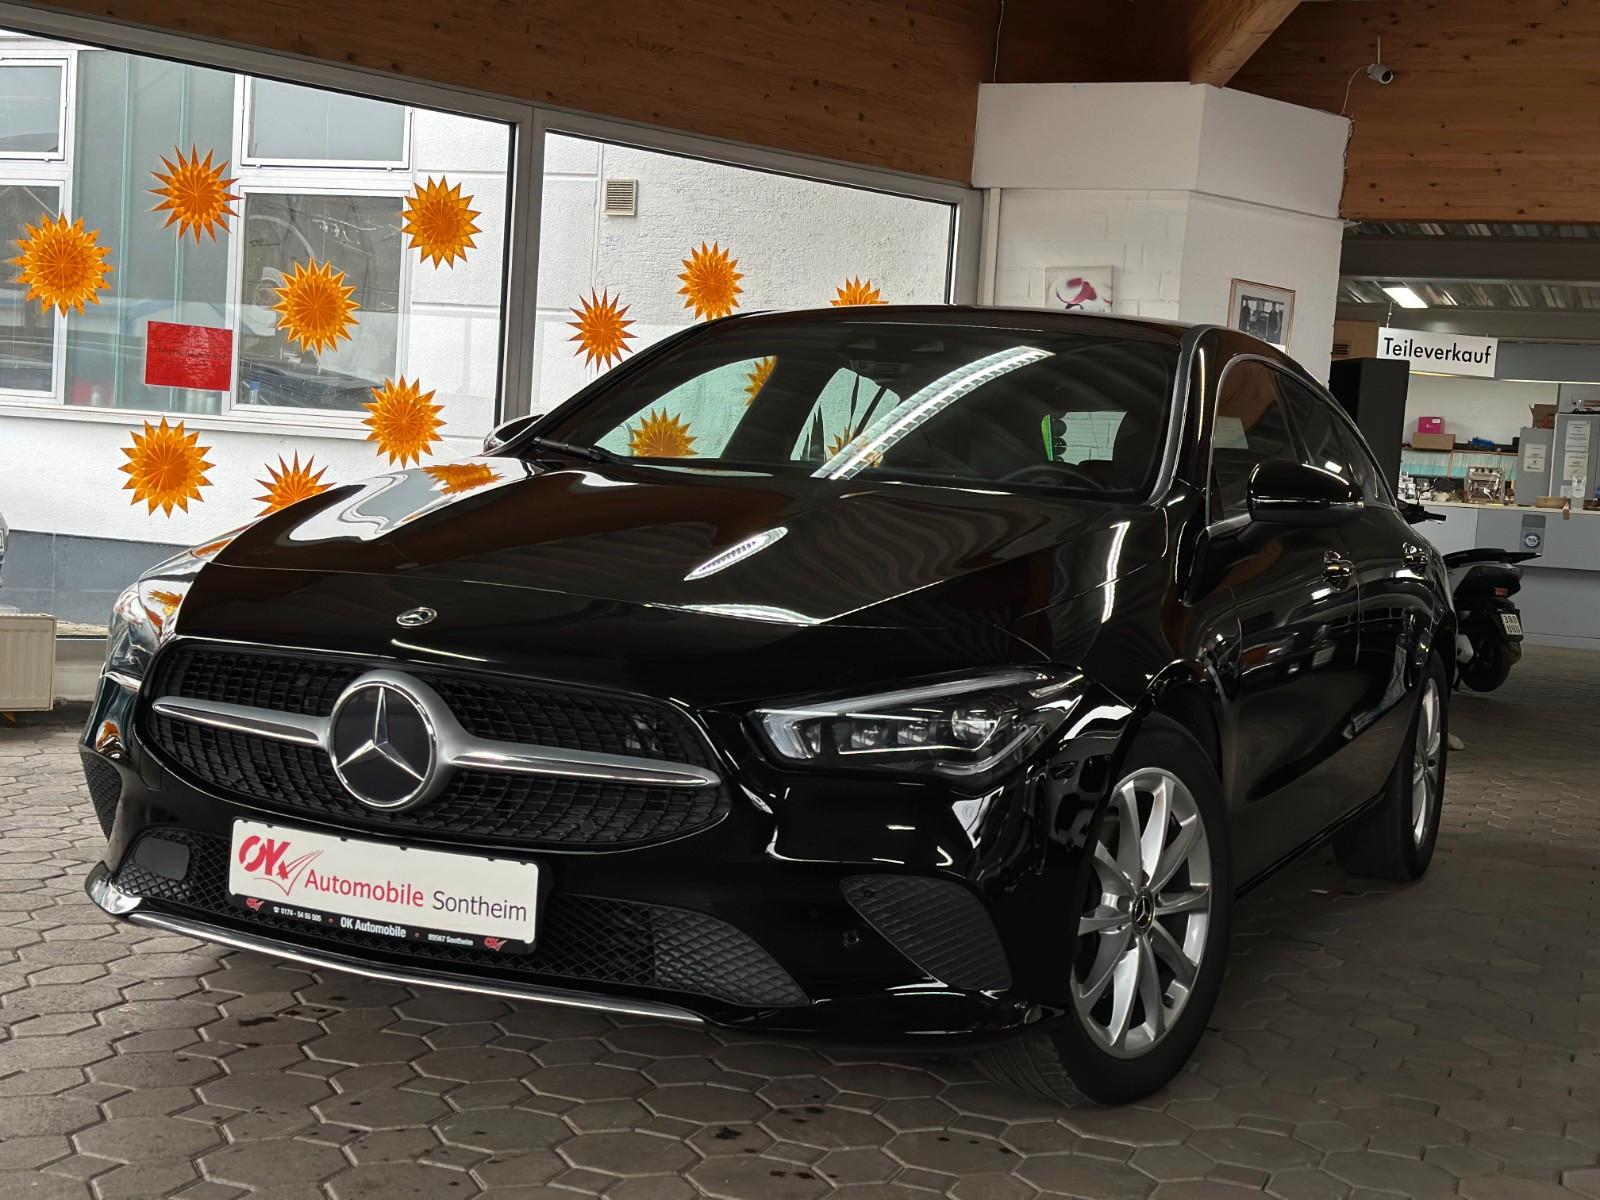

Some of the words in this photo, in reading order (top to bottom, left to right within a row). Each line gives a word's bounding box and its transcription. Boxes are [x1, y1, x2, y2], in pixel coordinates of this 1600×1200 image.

[1384, 337, 1492, 364] Teileverkauf
[238, 835, 291, 880] OK
[304, 869, 424, 907] Automobile
[432, 890, 527, 922] Sontheim
[340, 916, 354, 929] OK
[354, 919, 407, 938] Automobile
